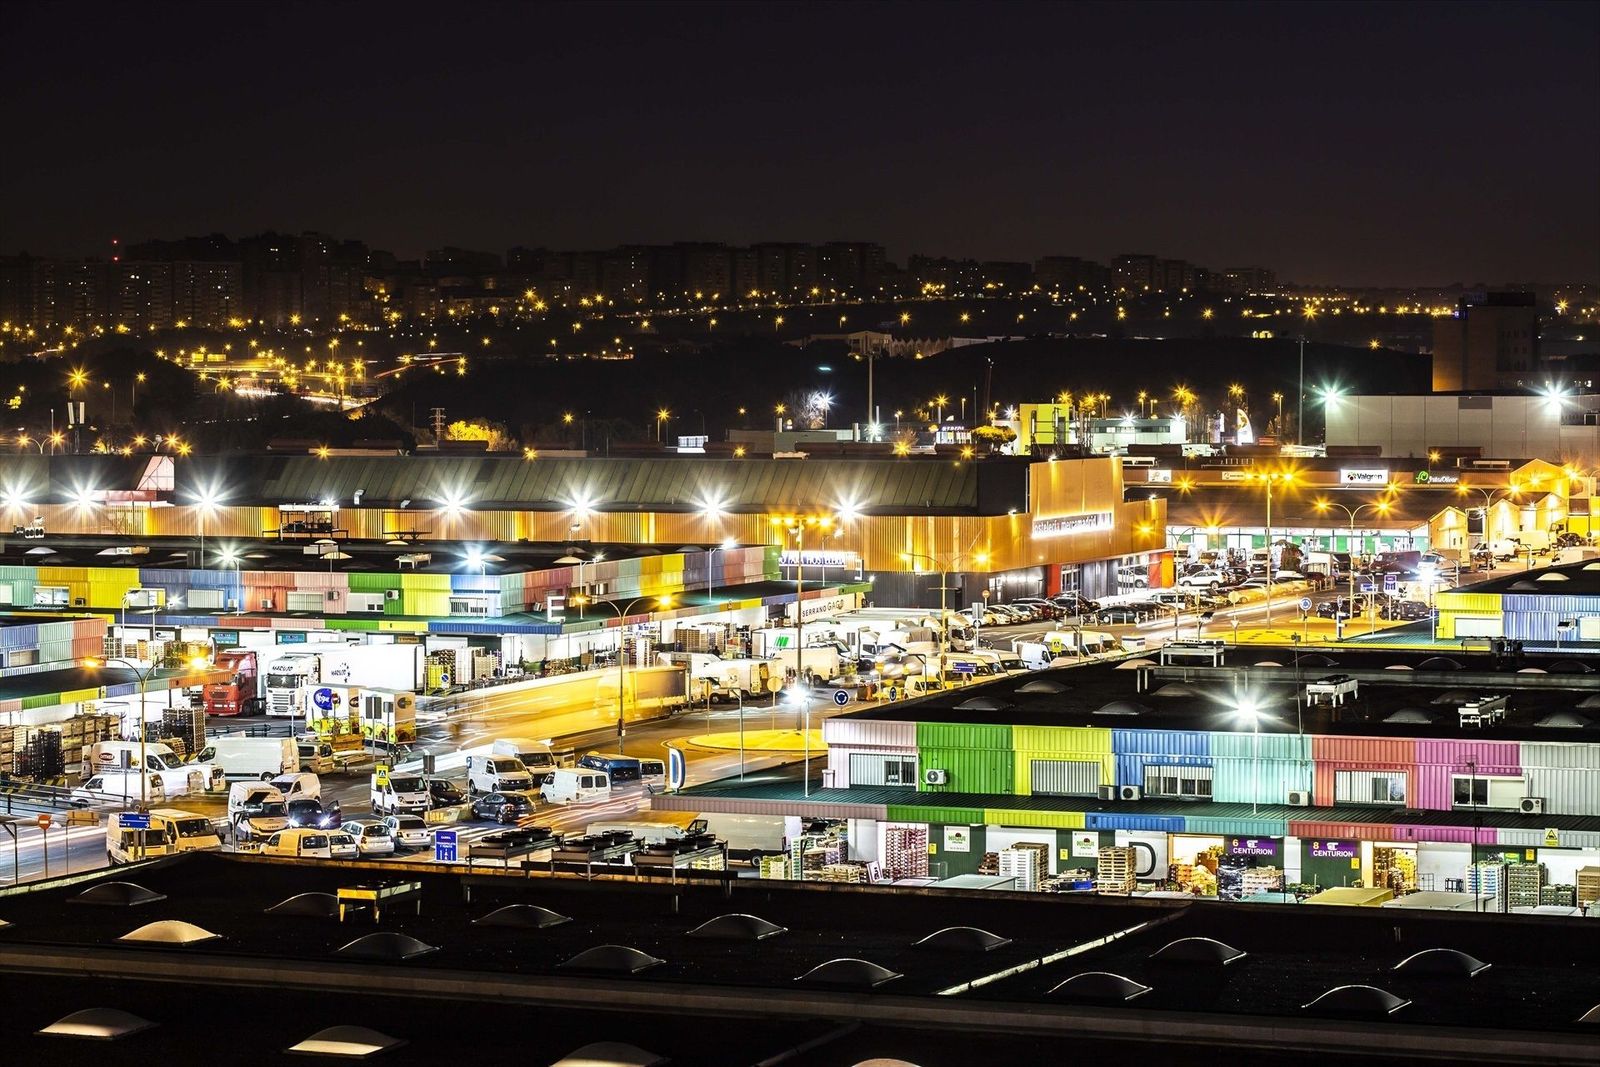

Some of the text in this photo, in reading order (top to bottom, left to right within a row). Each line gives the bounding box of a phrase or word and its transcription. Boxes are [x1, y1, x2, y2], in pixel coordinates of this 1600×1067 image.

[547, 595, 566, 623] E
[802, 605, 827, 618] SERRANO
[1232, 839, 1239, 847] 6
[1313, 841, 1320, 850] 8
[1232, 847, 1273, 855] CENTURION
